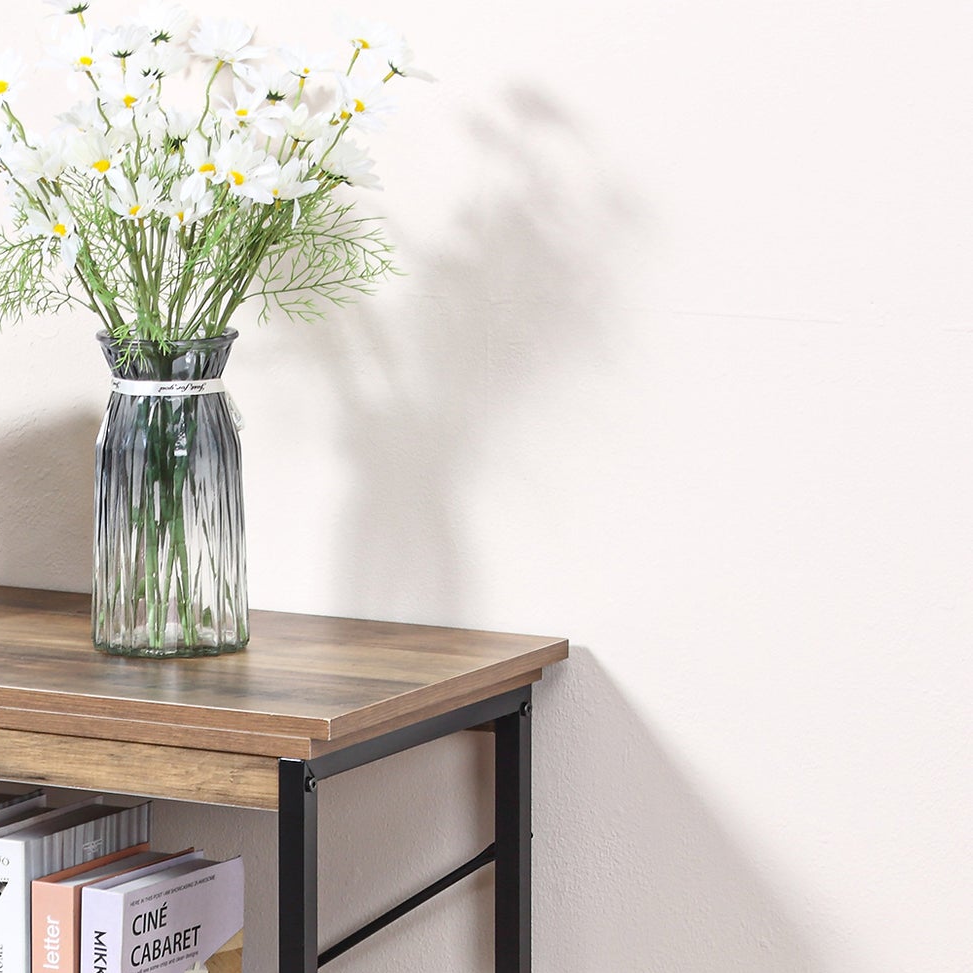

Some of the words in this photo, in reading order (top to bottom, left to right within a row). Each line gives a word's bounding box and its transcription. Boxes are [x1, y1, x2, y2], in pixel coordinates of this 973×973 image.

[132, 901, 168, 936] CINÉ
[42, 915, 60, 970] letter
[130, 924, 201, 967] CABARET
